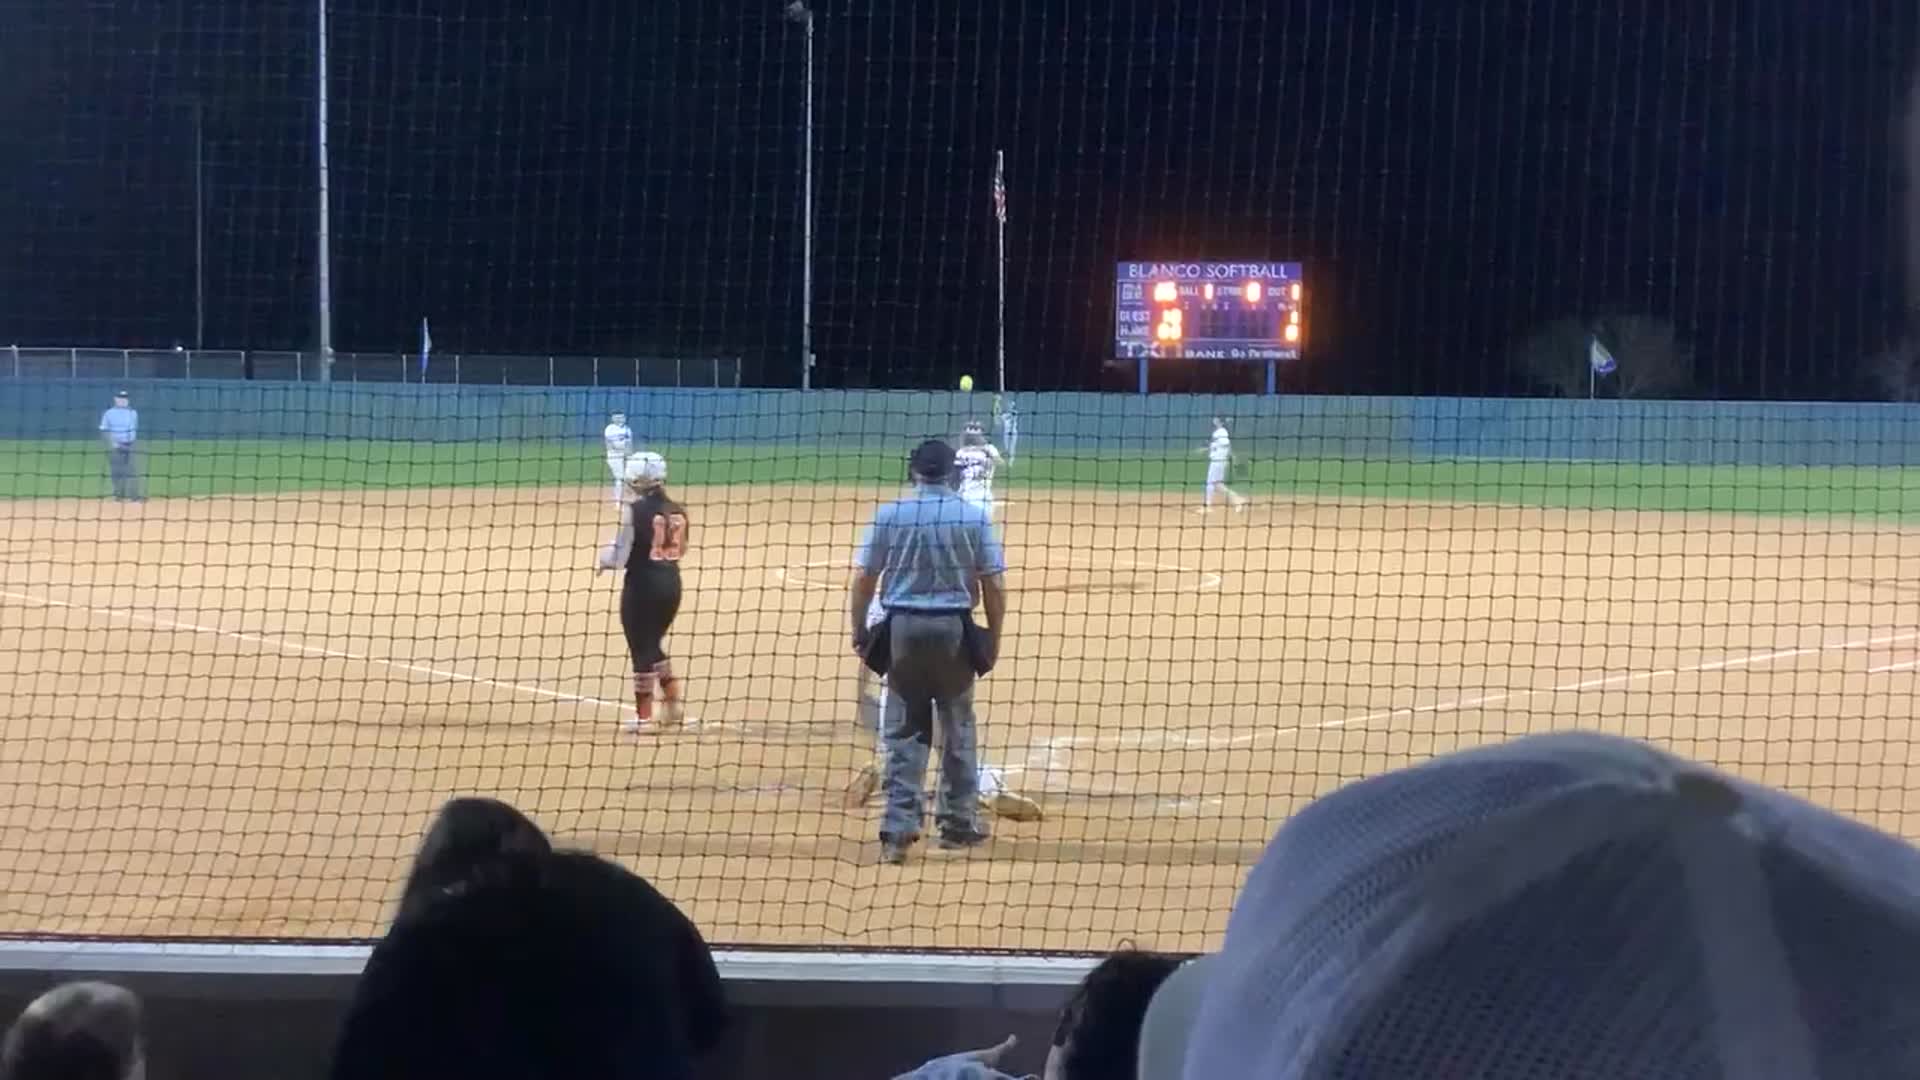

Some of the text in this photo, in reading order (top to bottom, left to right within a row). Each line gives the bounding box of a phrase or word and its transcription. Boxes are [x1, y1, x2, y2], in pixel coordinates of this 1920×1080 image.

[1128, 263, 1287, 279] BLANCO SOFTBALL
[1185, 350, 1226, 359] BANK
